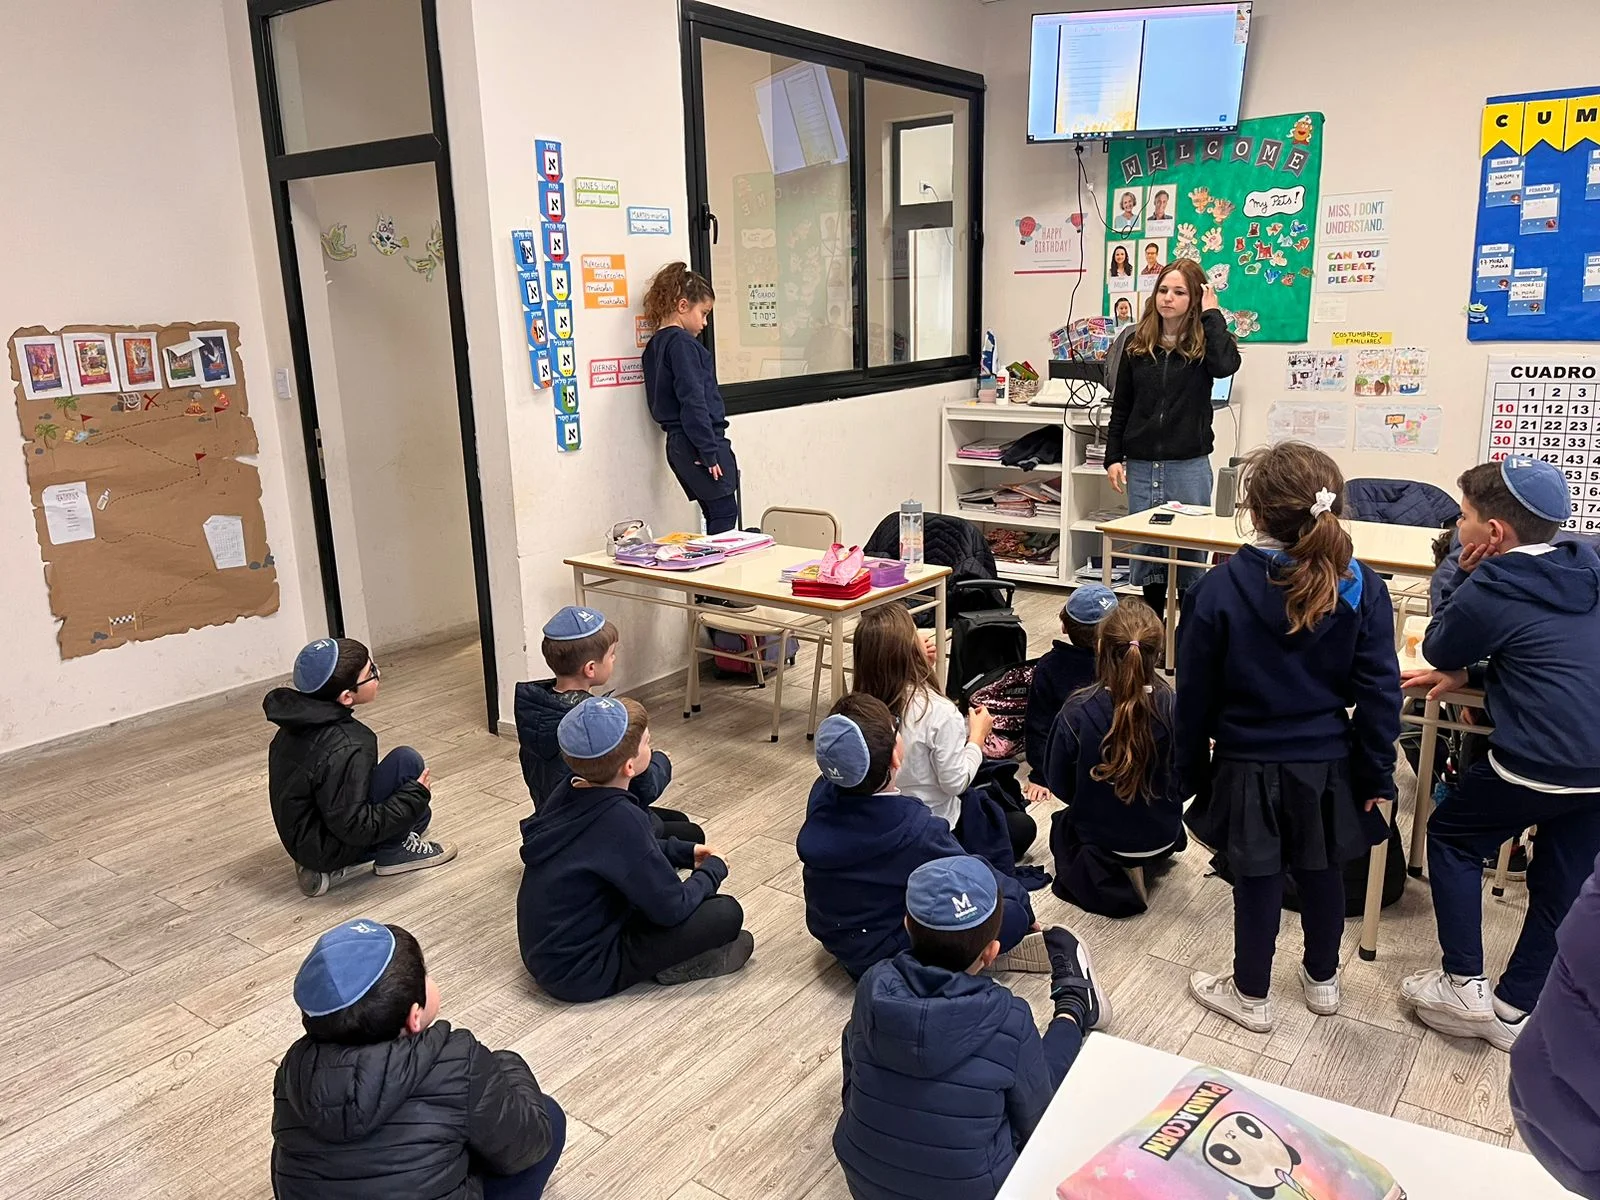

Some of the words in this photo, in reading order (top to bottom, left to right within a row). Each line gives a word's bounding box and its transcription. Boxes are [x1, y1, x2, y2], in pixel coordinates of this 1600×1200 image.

[1126, 140, 1304, 176] WELCOME
[1328, 204, 1351, 218] MISS,
[1353, 202, 1357, 216] I
[1359, 201, 1384, 215] DON'T
[1326, 218, 1385, 235] UNDERSTAND.
[1041, 227, 1062, 241] HAPPY
[1034, 239, 1071, 254] BIRTHDAY!
[1327, 251, 1353, 260] CAN
[1357, 249, 1380, 259] YOU
[1328, 262, 1376, 272] REPEAT,
[1327, 274, 1375, 284] PLEASE?
[1511, 366, 1597, 379] CUADRO
[1529, 388, 1535, 397] 1
[1552, 388, 1561, 397] 2
[1578, 388, 1587, 397] 3
[1497, 404, 1514, 413] 10
[1522, 405, 1538, 414] 11
[1546, 405, 1563, 414] 12
[1572, 405, 1589, 415] 13
[1495, 420, 1512, 429] 20
[1520, 420, 1537, 430] 21
[1544, 421, 1562, 430] 22
[1569, 421, 1588, 431] 23
[1493, 436, 1511, 445] 30
[1519, 436, 1535, 446] 31
[1542, 437, 1560, 446] 32
[1568, 438, 1586, 447] 33
[1540, 454, 1558, 463] 42
[1566, 454, 1584, 464] 43
[1565, 470, 1582, 480] 53
[951, 892, 972, 912] M
[1476, 983, 1484, 999] FILA
[1142, 1082, 1231, 1157] PANDACORN
